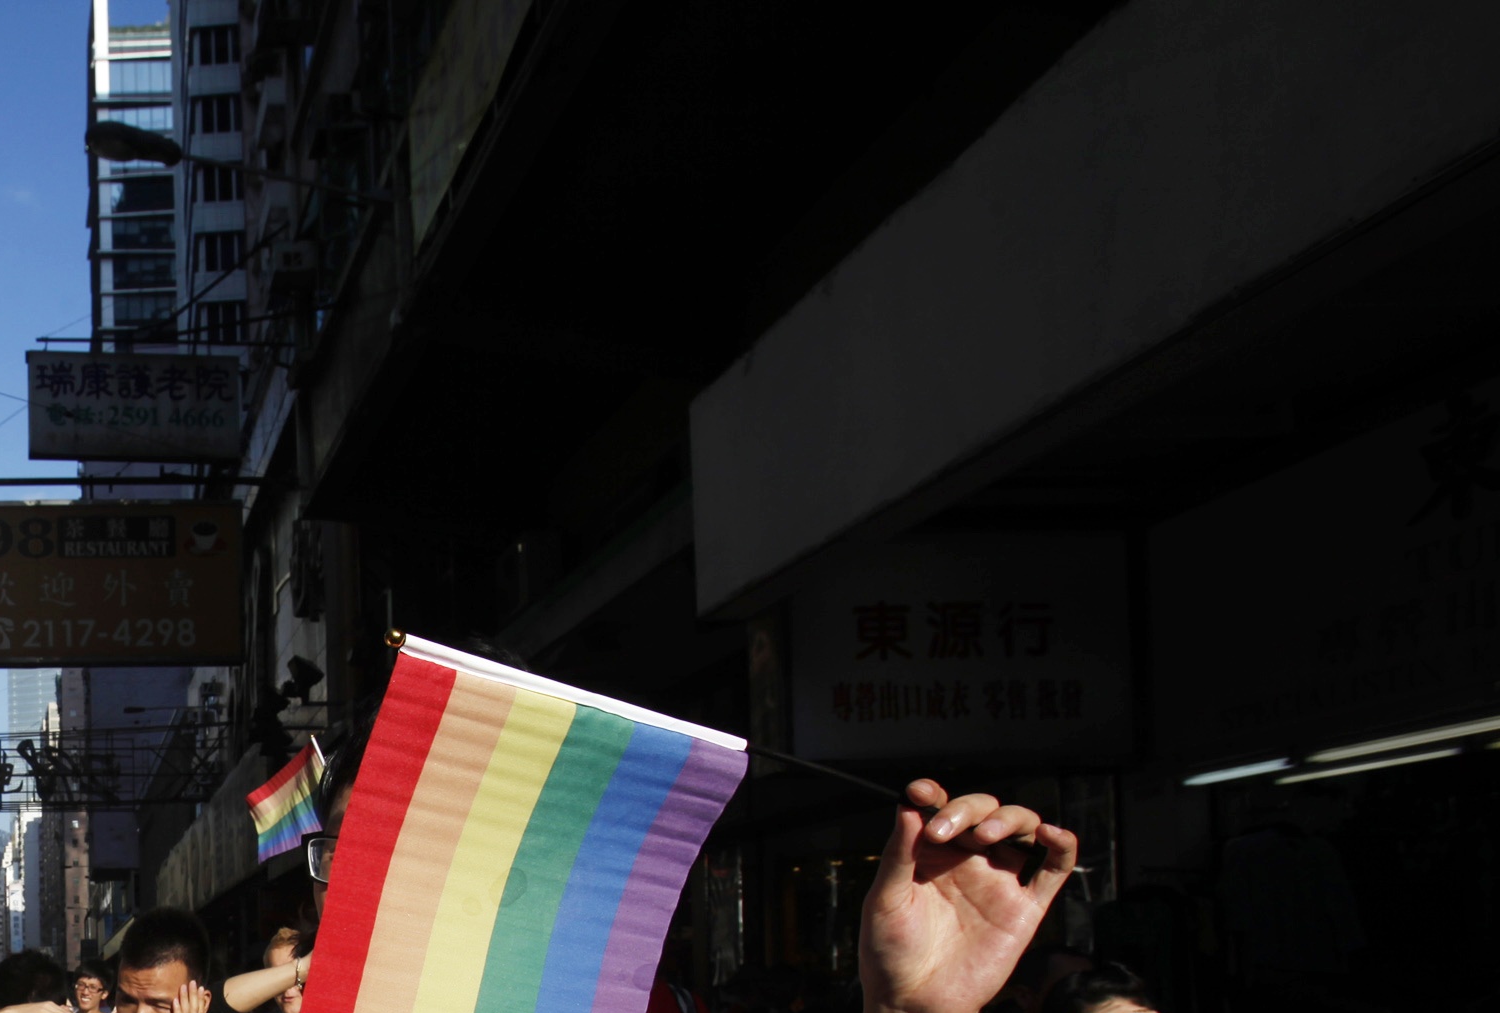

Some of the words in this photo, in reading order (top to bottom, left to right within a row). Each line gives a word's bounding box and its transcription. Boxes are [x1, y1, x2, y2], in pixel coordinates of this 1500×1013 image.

[36, 361, 234, 401] 瑞康護老院
[169, 406, 225, 427] 4666
[64, 540, 170, 557] RESTAURANT
[22, 619, 196, 648] 2117-4298
[852, 601, 1054, 660] 東源行
